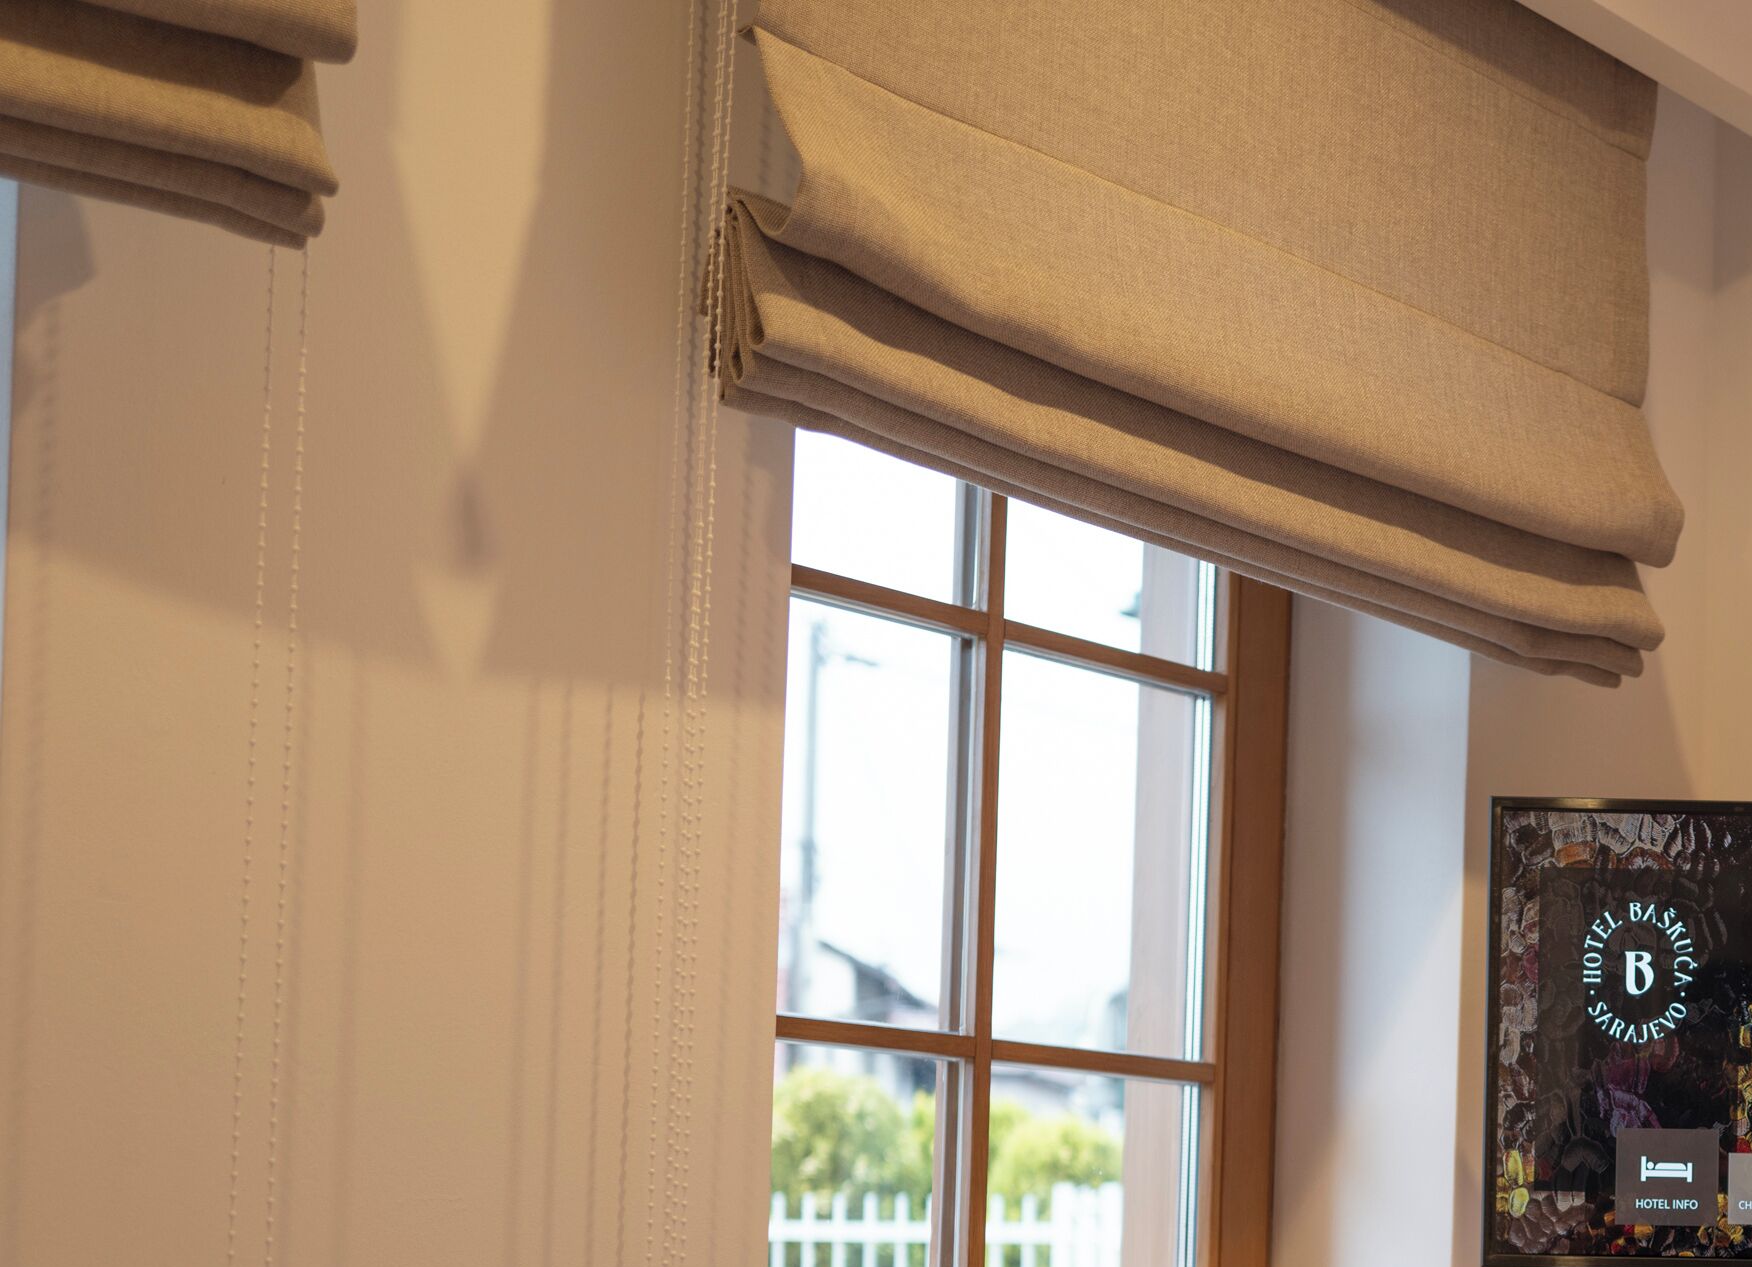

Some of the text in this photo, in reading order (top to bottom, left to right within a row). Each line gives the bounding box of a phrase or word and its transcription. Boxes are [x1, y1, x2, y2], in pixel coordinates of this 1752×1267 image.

[1583, 911, 1623, 983] HOTEL
[1625, 951, 1654, 995] B
[1588, 1001, 1687, 1043] SARAJEVO
[1635, 1199, 1698, 1210] HOTEL INFO
